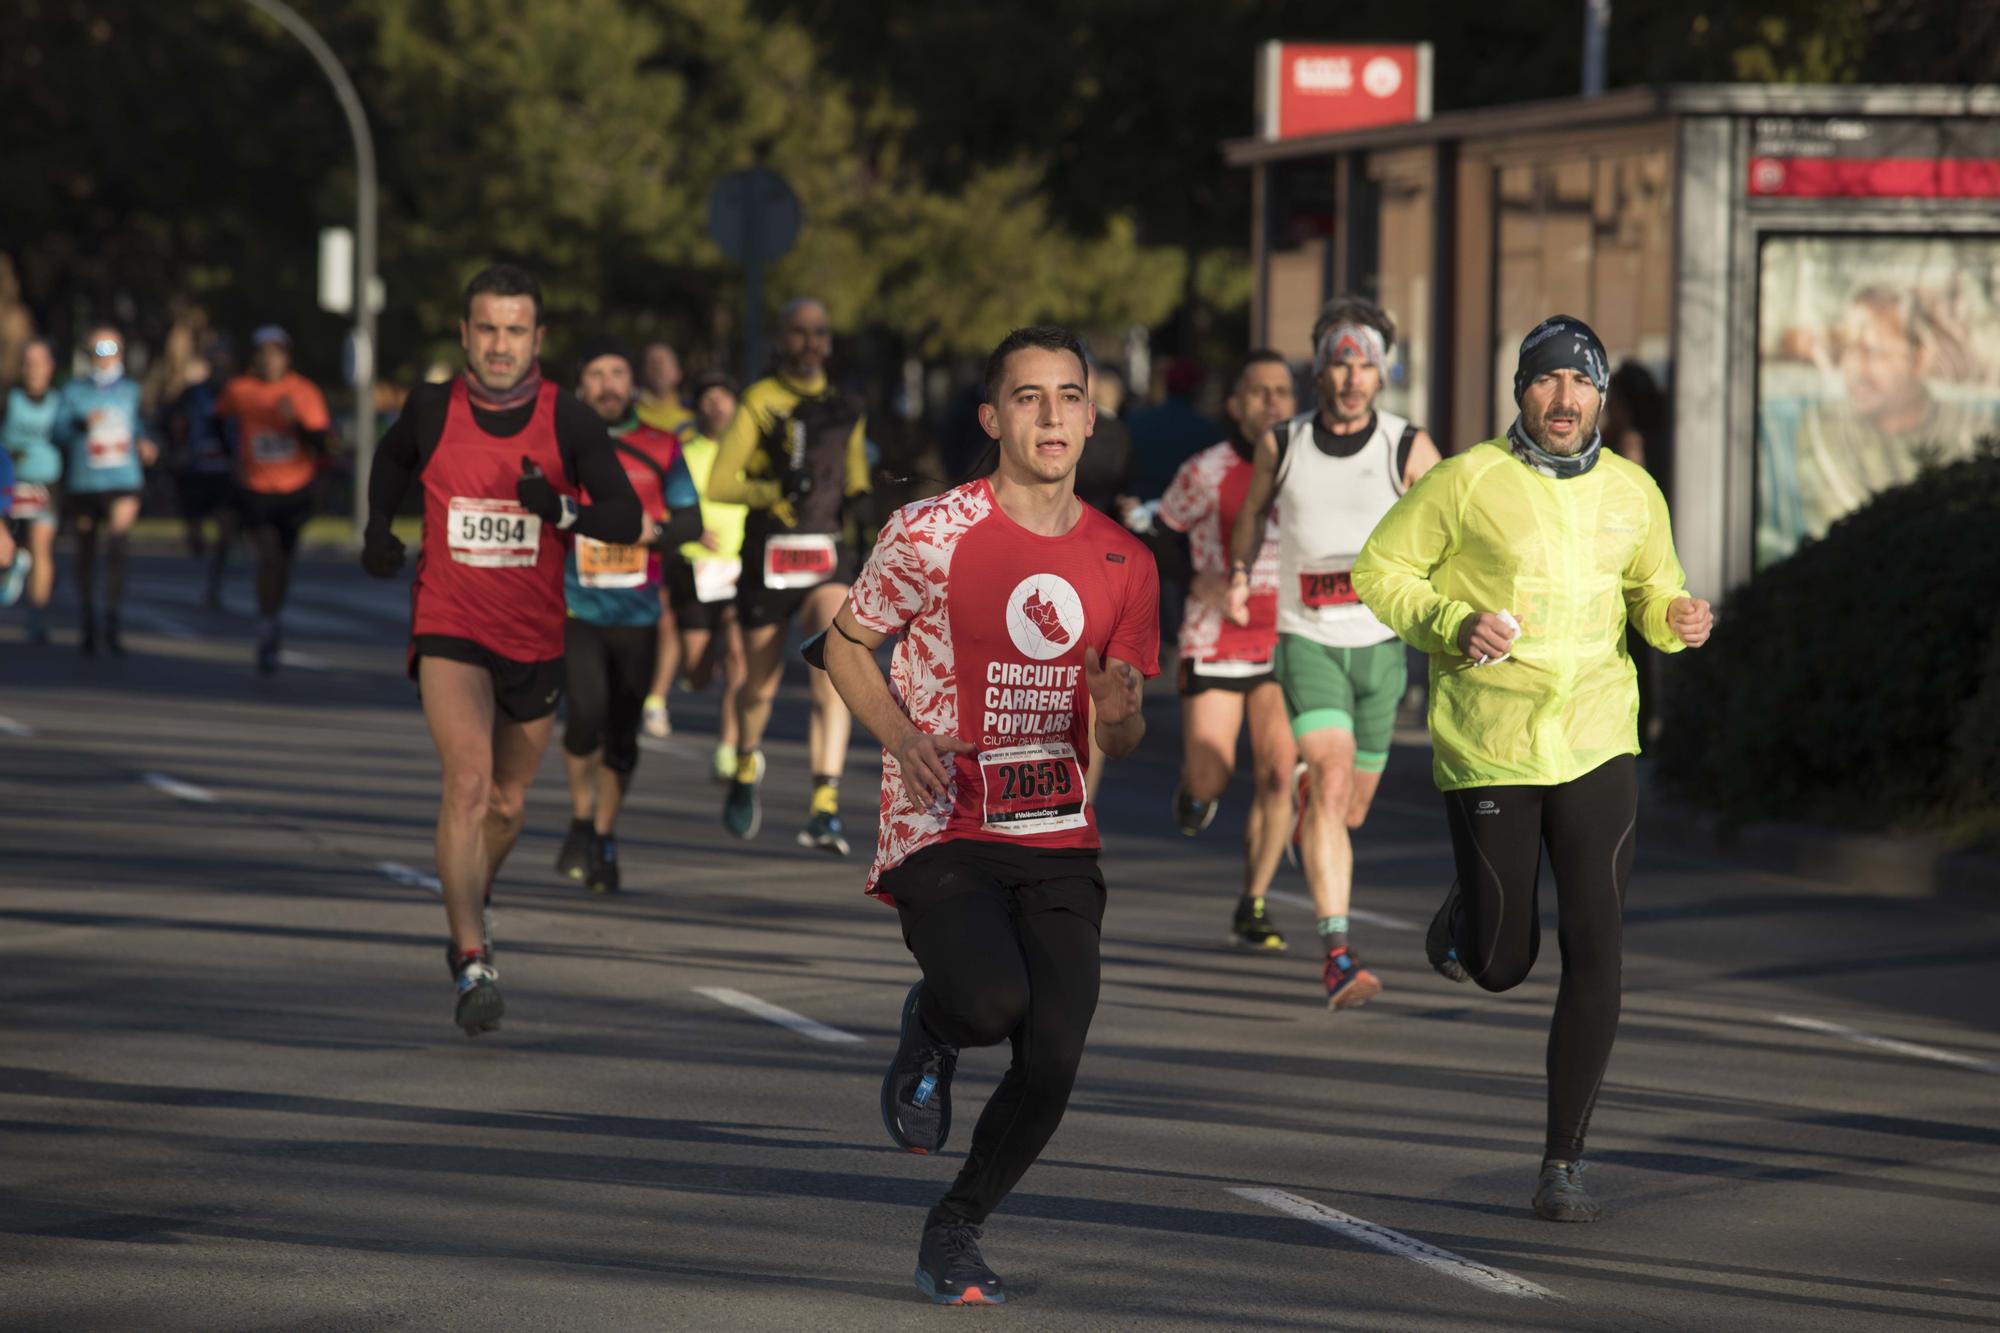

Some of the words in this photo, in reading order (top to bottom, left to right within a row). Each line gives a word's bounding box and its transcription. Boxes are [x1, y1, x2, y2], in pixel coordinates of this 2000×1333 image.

[463, 516, 525, 542] 5994
[987, 661, 1065, 687] CIRCUIT
[1066, 665, 1081, 687] DE
[983, 711, 1073, 735] POPULARS
[999, 760, 1072, 800] 2659
